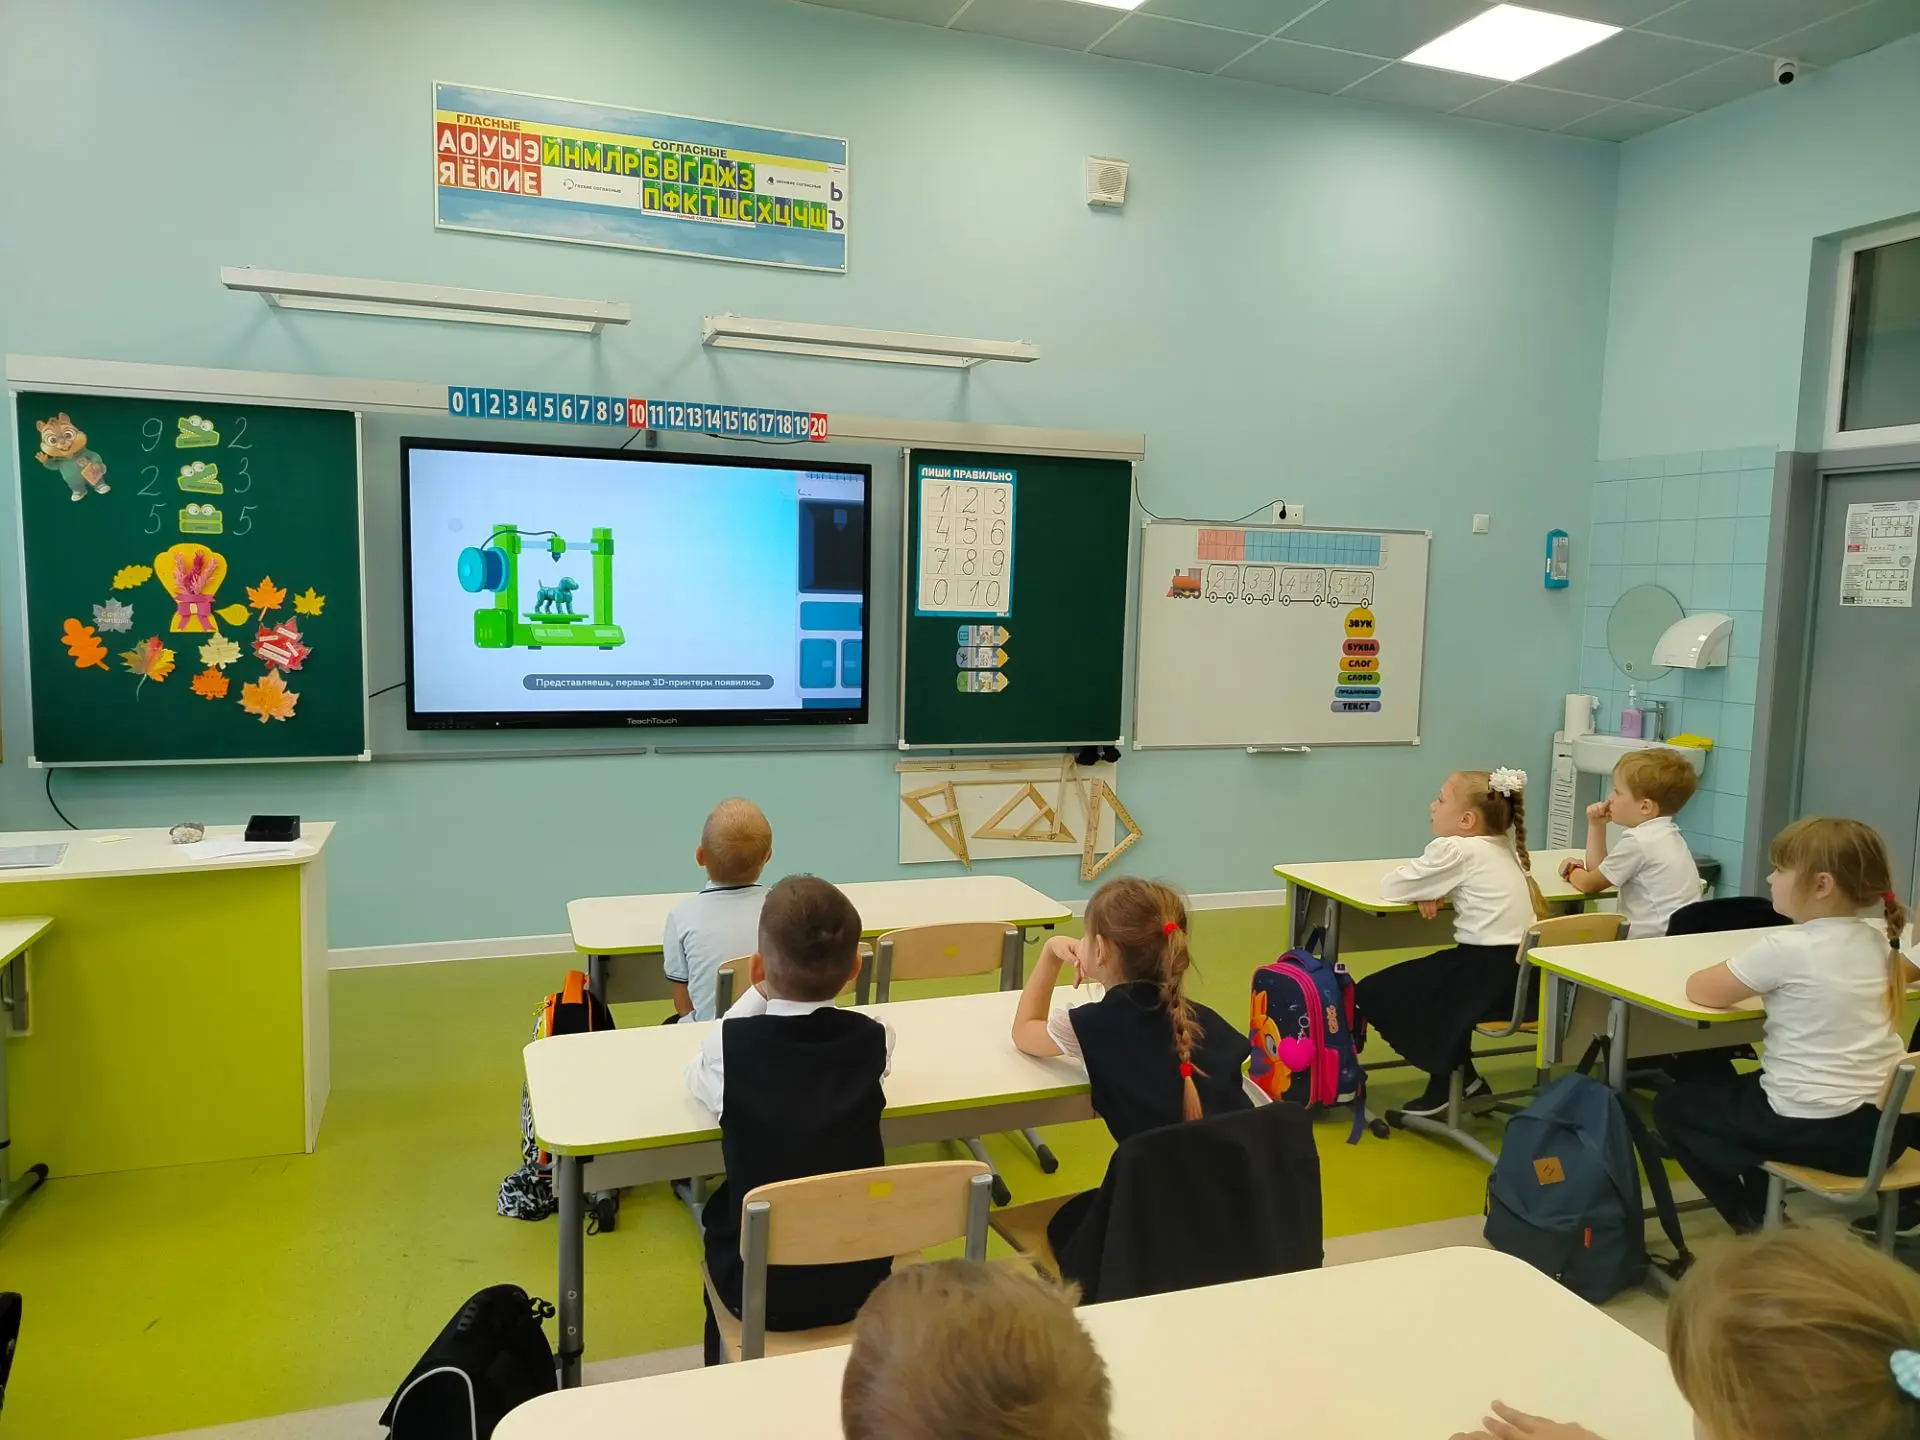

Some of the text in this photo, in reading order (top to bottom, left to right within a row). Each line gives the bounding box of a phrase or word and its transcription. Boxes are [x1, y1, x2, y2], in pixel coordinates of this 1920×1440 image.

[457, 114, 521, 131] ГЛАСНЫЕ
[652, 140, 728, 159] СОГЛАСНЫЕ
[830, 181, 843, 202] Ь
[828, 210, 844, 230] Ъ
[453, 392, 827, 437] 0 1 2 3 4 5 6 7 8 9 10 11 12 13 14 15 16 17 18 19 20
[141, 416, 253, 452] 9 2
[137, 456, 251, 496] 2 3
[921, 467, 1013, 482] ПИШИ ПРАВИЛЬНО
[940, 486, 1007, 515] 1 2 3
[144, 503, 258, 536] 5 5
[936, 516, 1006, 545] 4 5 6
[934, 547, 1005, 576] 7 8 9
[1213, 571, 1225, 588] 2
[1249, 573, 1260, 590] 3
[1287, 575, 1296, 591] 4
[1335, 577, 1348, 593] 5
[933, 579, 1000, 607] 0 10
[1348, 619, 1372, 628] ЗВУК
[1347, 643, 1375, 651] БУКВА
[1348, 660, 1372, 668] СЛОГ
[535, 677, 761, 689] Представляешь, первые 3D-принтеры появились
[1342, 702, 1371, 711] ТЕКСТ
[626, 717, 678, 725] TeachTouch
